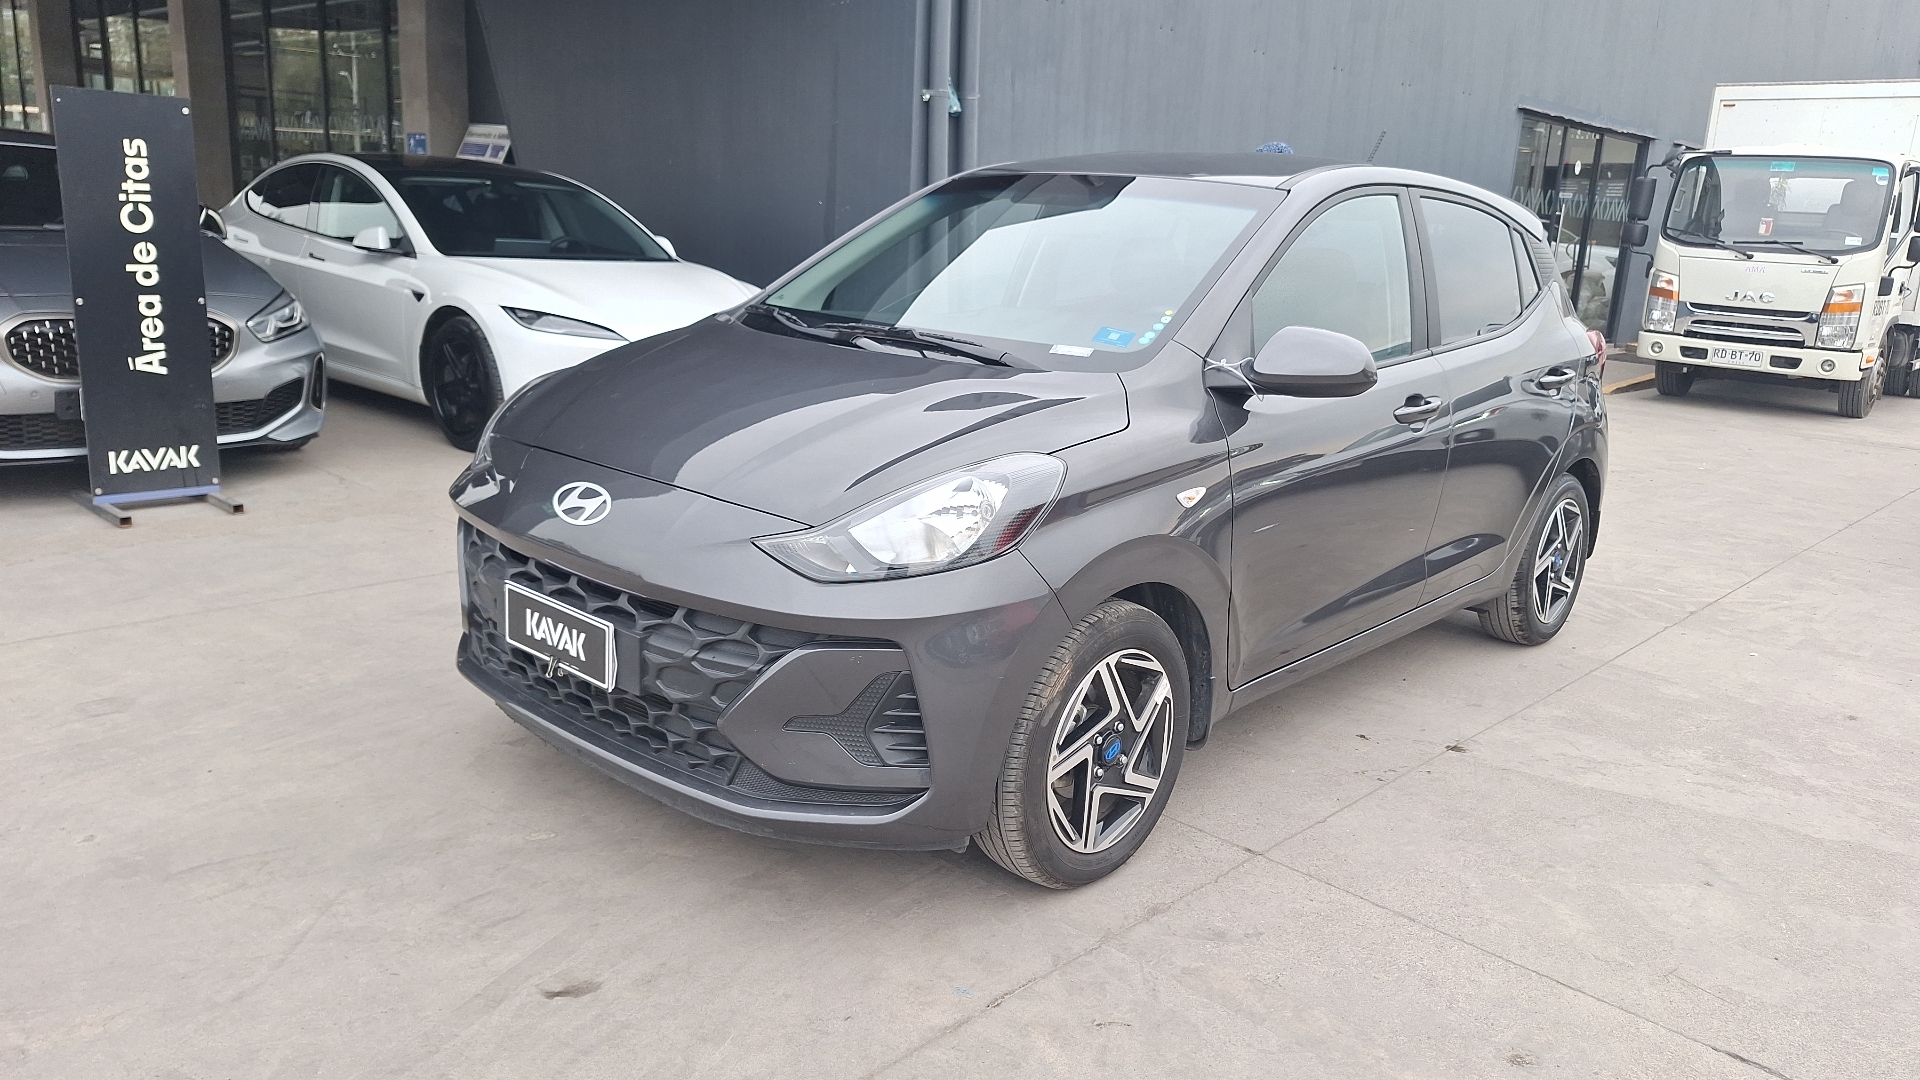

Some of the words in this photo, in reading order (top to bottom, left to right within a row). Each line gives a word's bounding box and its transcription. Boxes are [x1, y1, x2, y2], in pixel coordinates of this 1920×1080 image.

[118, 138, 154, 234] Citas
[125, 241, 160, 287] de
[1724, 289, 1775, 304] JAC
[127, 294, 168, 375] Área
[107, 444, 201, 475] KAVAK
[525, 608, 586, 662] KAVAK
